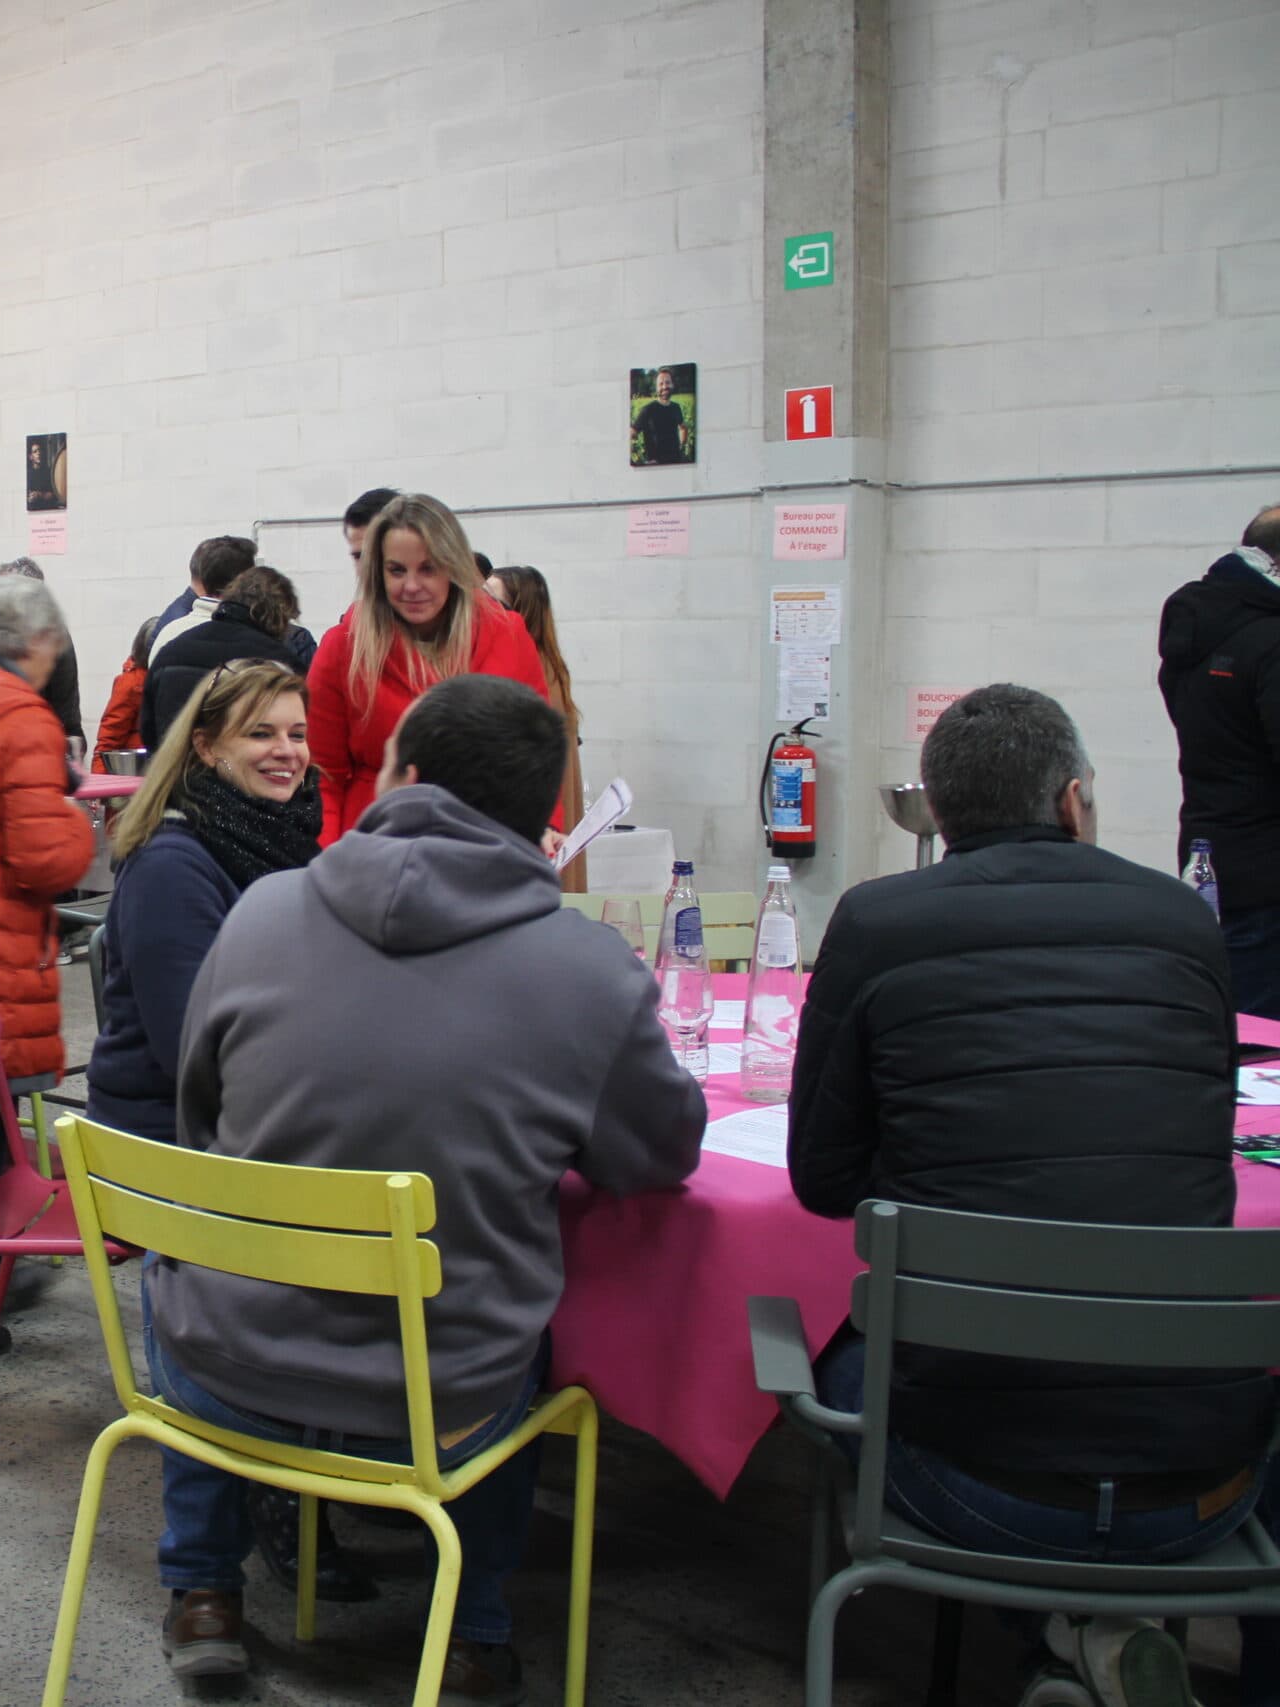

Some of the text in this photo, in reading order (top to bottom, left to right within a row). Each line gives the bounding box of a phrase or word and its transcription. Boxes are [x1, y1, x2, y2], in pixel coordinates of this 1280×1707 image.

[783, 511, 835, 522] Bureau pour
[780, 526, 838, 535] COMMANDES
[798, 541, 827, 552] l'étage
